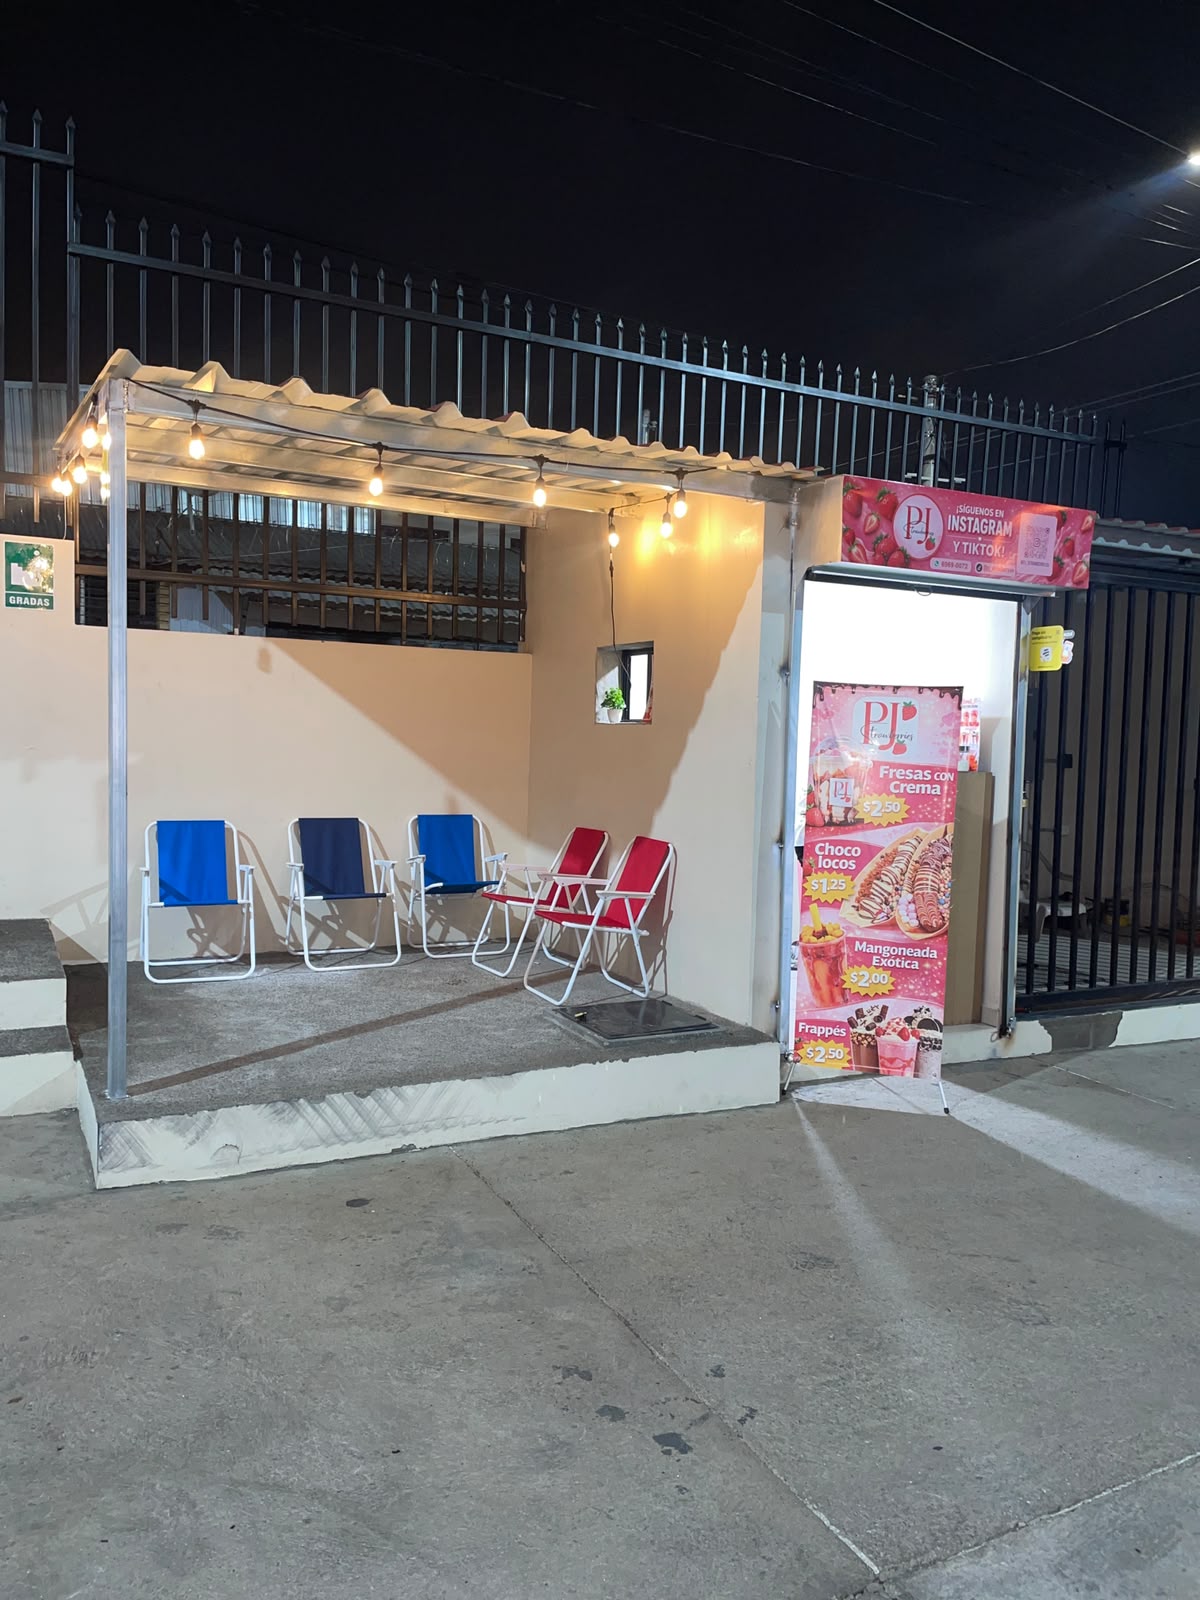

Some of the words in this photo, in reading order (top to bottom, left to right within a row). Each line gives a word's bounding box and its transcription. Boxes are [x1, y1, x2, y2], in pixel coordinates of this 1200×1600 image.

[956, 504, 994, 518] ¡SÍGUENOS
[995, 509, 1004, 518] EN
[904, 505, 932, 545] PJ
[948, 514, 1013, 537] INSTAGRAM
[953, 541, 960, 553] Y
[962, 542, 1005, 558] TIKTOK!
[9, 595, 50, 607] GRADAS
[862, 701, 901, 751] PJ
[879, 765, 931, 780] Fresas
[889, 781, 941, 795] Crema
[863, 799, 901, 817] $2.50
[815, 843, 861, 857] Choco
[818, 856, 857, 870] locos
[811, 878, 846, 894] $1.25
[854, 941, 938, 959] Mangoneada
[872, 956, 919, 970] Exótica
[850, 971, 889, 988] $2.00
[798, 1022, 847, 1038] Frappés
[806, 1046, 844, 1063] $2.50
